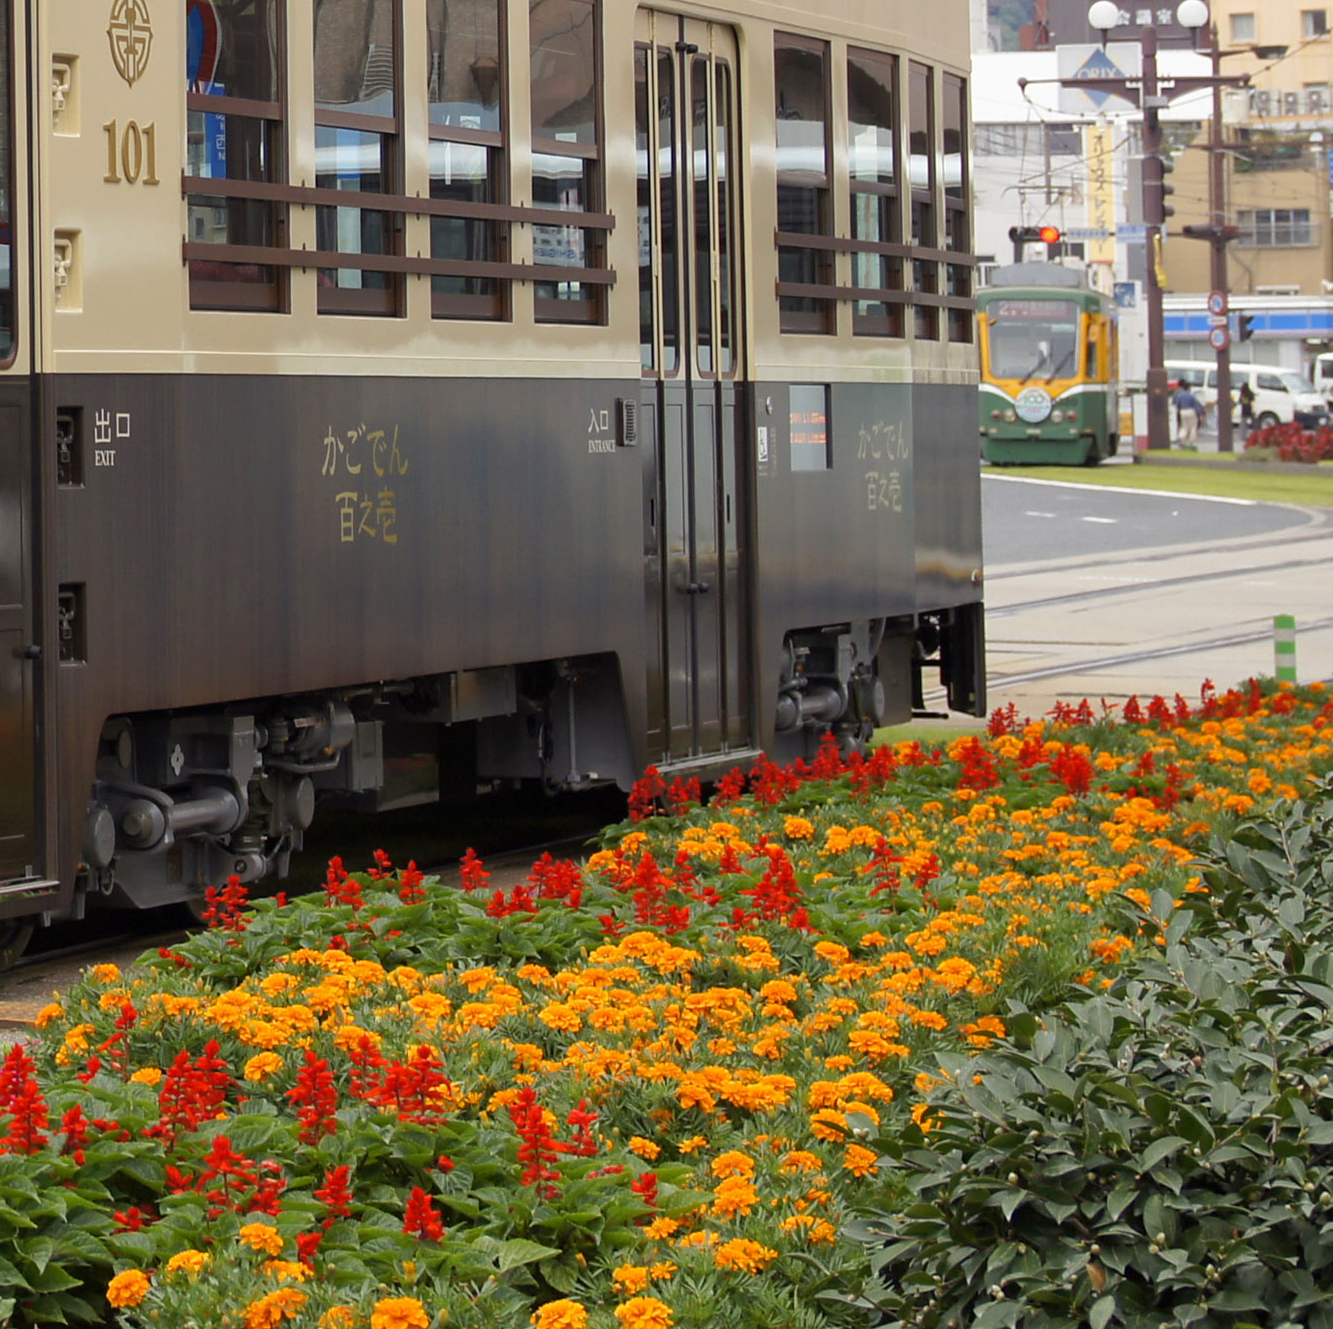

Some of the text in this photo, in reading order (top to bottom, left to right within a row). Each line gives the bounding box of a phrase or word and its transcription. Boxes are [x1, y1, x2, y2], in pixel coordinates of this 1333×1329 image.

[102, 118, 161, 185] 101
[94, 408, 131, 444] 出口
[588, 408, 609, 433] 入口
[856, 419, 910, 461] かごでん
[95, 449, 117, 466] EXIT
[321, 422, 410, 478] かごでん
[588, 438, 616, 454] ENTRANCE
[864, 467, 903, 513] 百之壱
[334, 485, 398, 544] 百之壱
